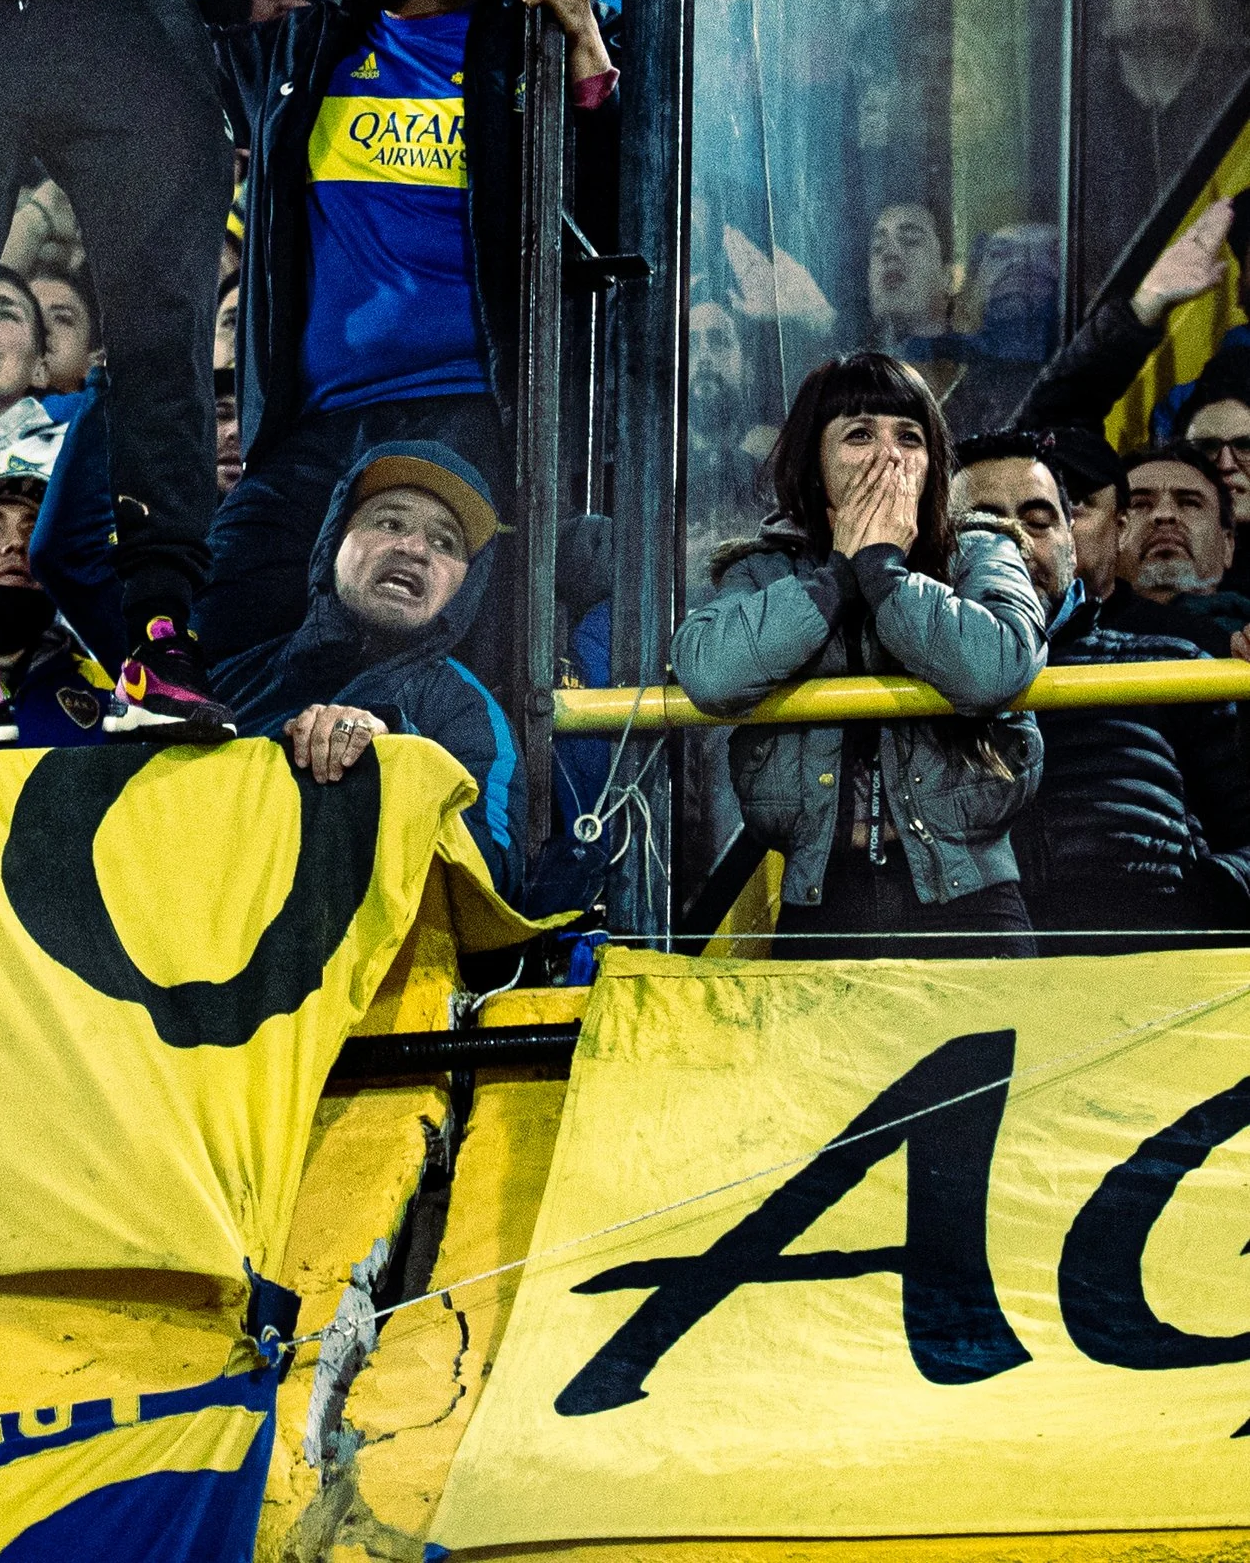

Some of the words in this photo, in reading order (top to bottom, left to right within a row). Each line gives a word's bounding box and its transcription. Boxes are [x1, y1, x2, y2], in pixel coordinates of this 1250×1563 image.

[349, 111, 467, 149] QATAR
[370, 147, 468, 171] AIRWAYS
[872, 770, 881, 795] YORK
[871, 796, 880, 817] NEW
